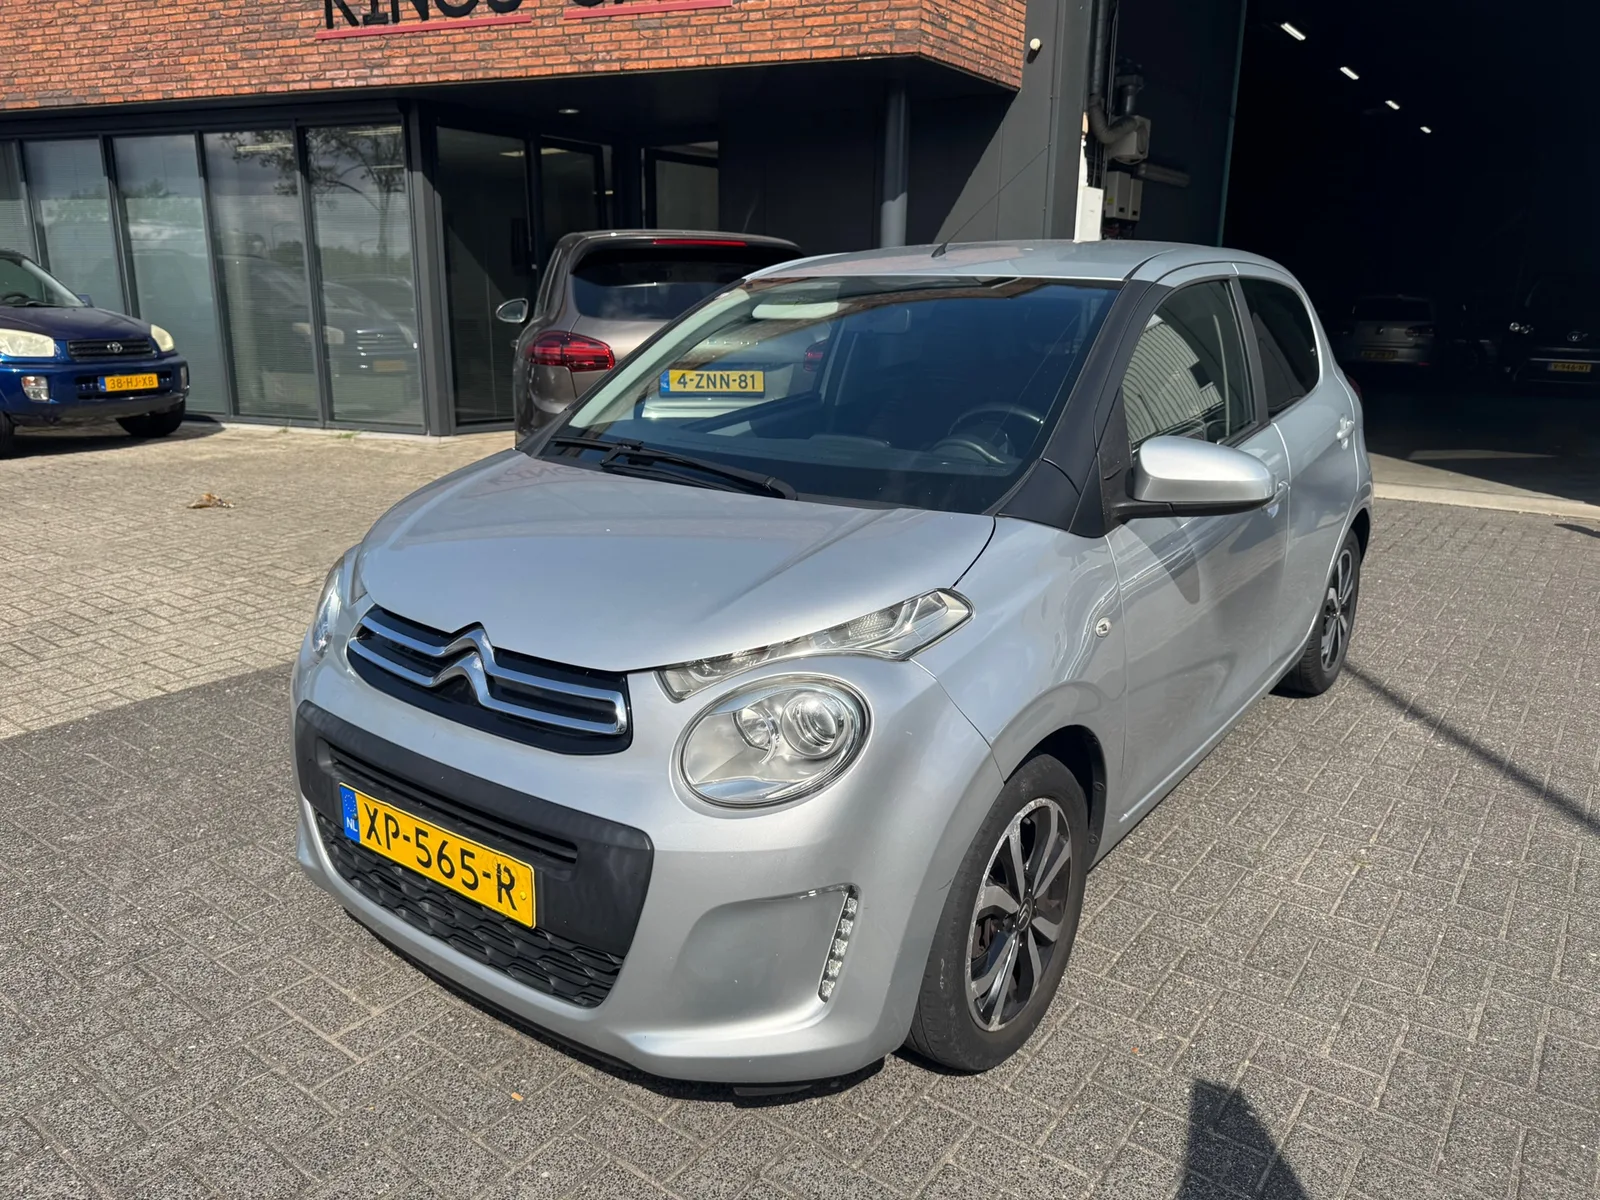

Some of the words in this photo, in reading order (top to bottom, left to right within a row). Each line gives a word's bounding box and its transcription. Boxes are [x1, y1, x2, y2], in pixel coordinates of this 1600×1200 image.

[677, 373, 756, 390] 4-ZNN-81
[346, 817, 358, 833] NL
[364, 803, 517, 911] XP-565-R
